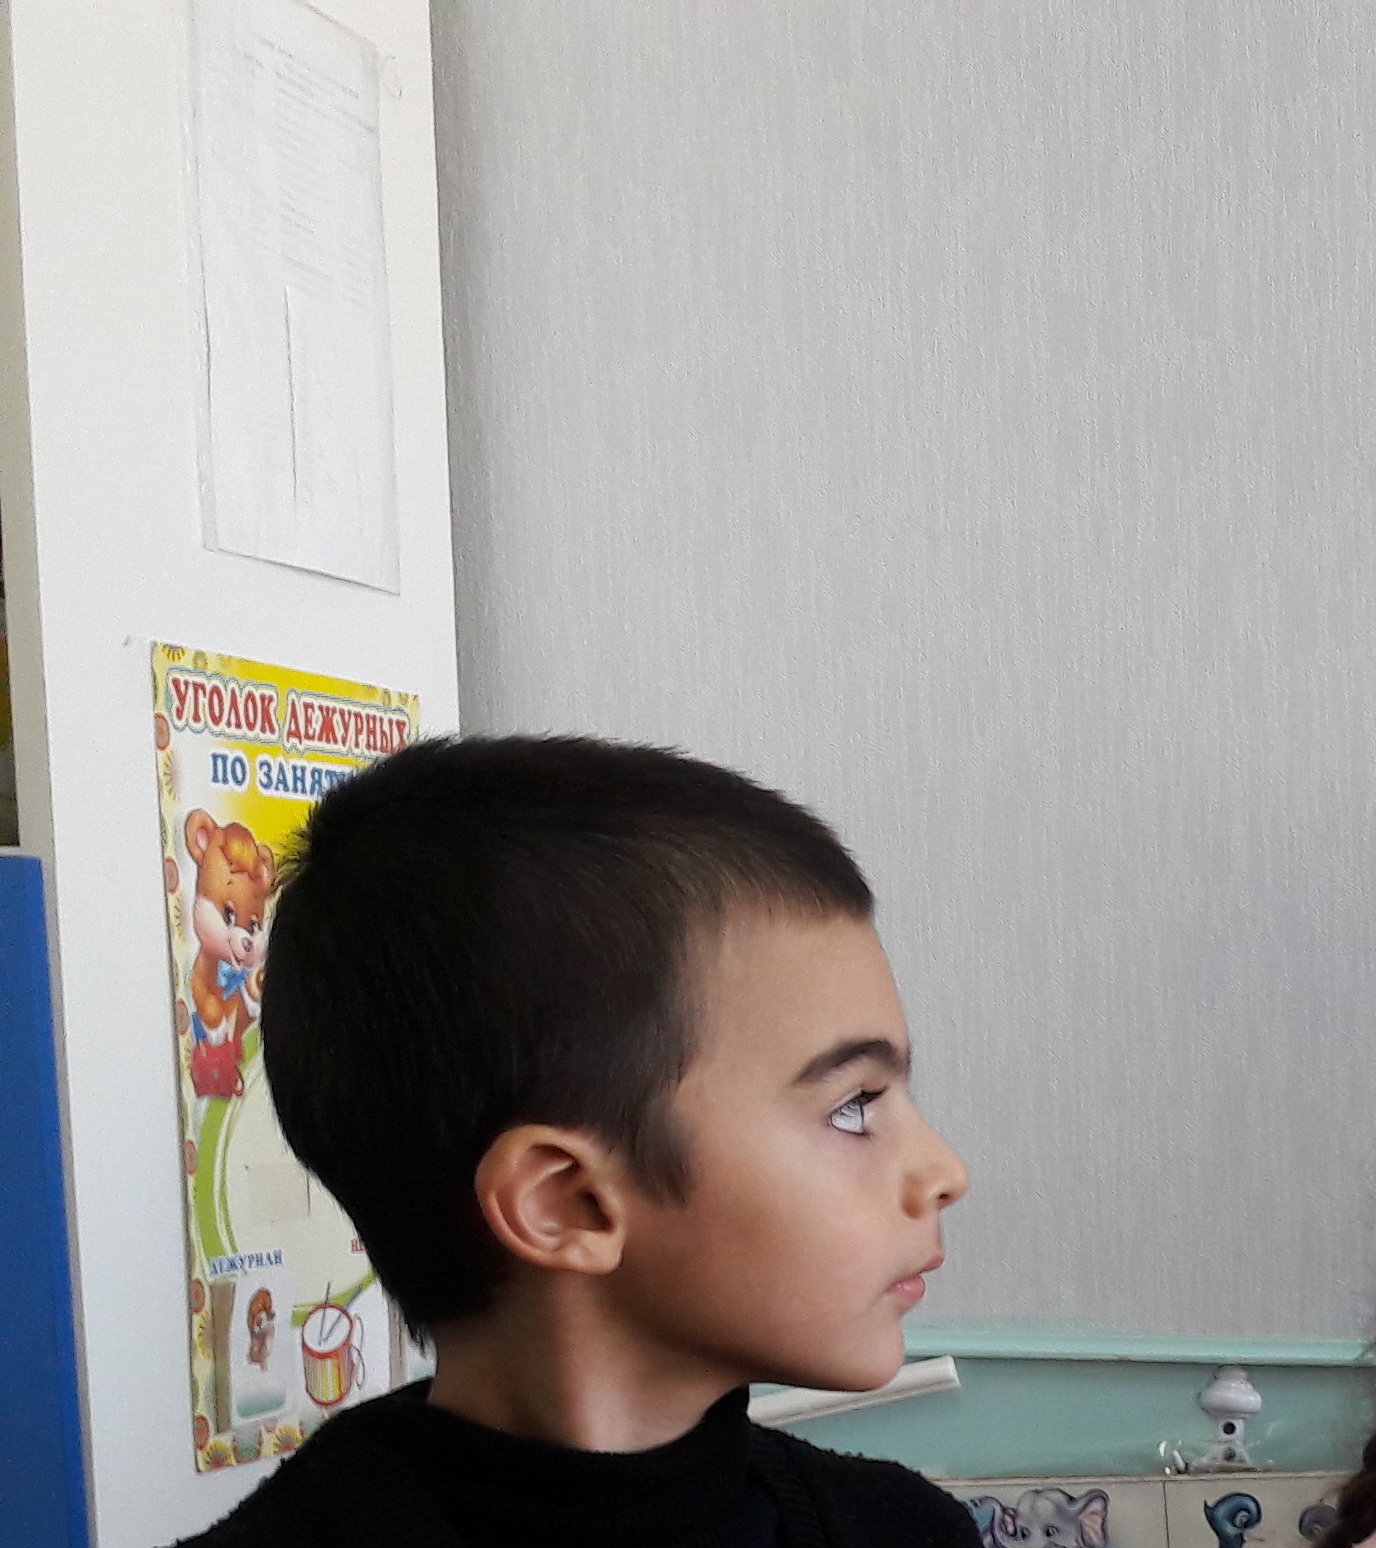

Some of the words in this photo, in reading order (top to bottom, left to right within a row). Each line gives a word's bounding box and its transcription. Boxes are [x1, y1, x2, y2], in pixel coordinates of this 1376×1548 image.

[171, 678, 277, 736] УГОЛОК
[284, 697, 409, 753] ДЕЖУРНЫХ
[211, 752, 247, 786] ПО
[259, 759, 353, 794] ЗАНЯТ
